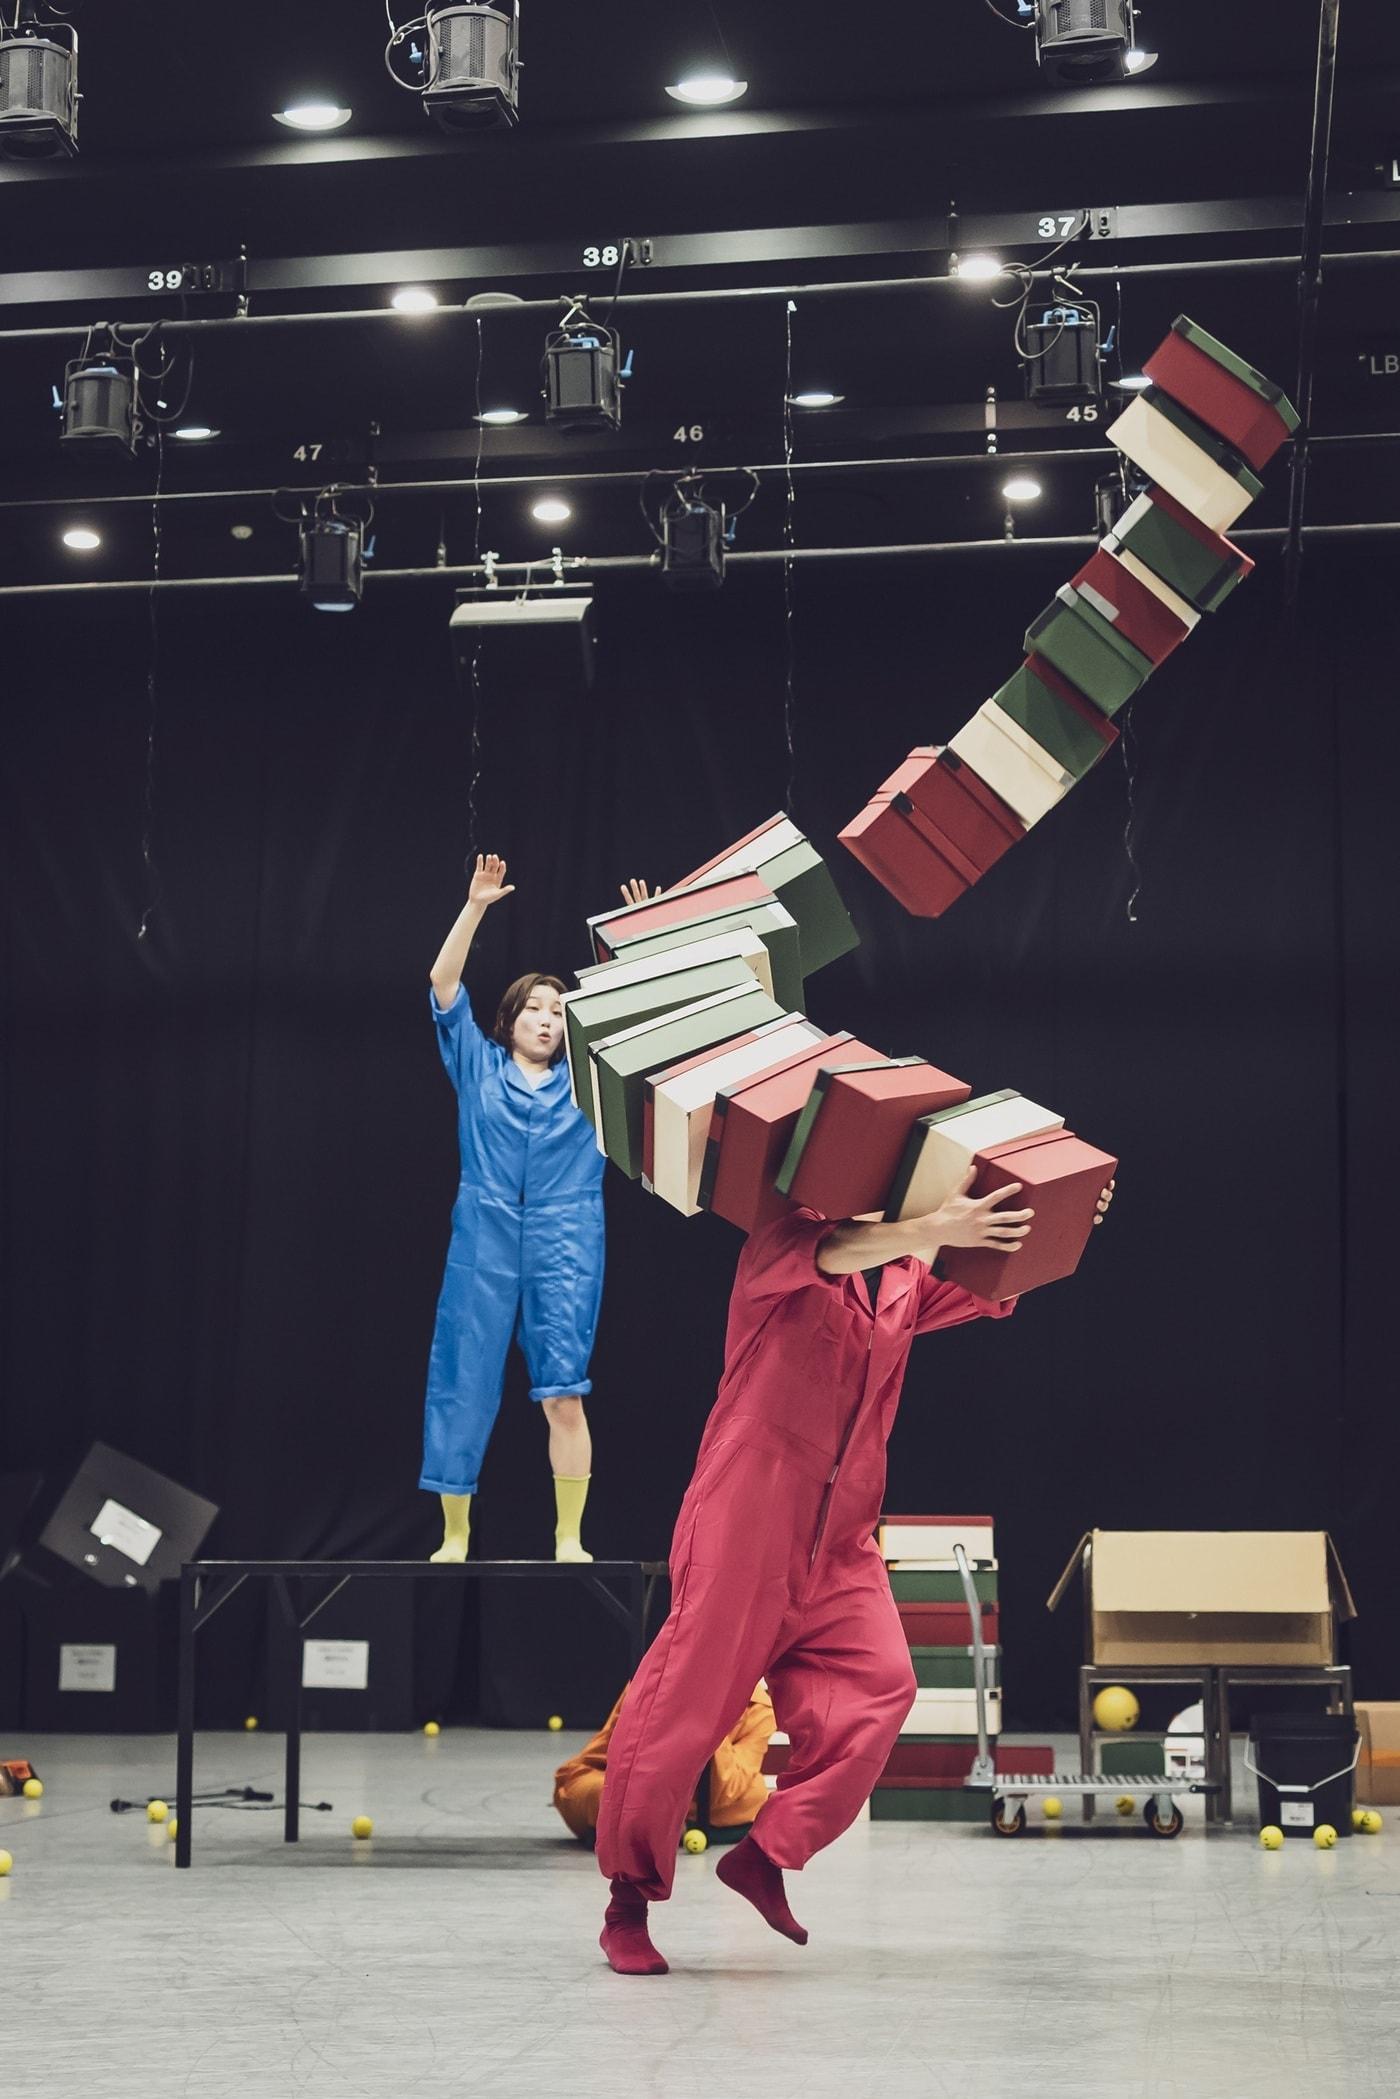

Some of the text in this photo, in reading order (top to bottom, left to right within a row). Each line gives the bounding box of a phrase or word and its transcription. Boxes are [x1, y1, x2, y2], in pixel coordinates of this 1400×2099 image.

[1038, 217, 1076, 238] 37
[583, 246, 619, 267] 38
[148, 270, 182, 290] 39
[1371, 355, 1400, 374] LB
[1066, 404, 1098, 422] 45
[673, 425, 703, 442] 46
[293, 444, 322, 461] 47
